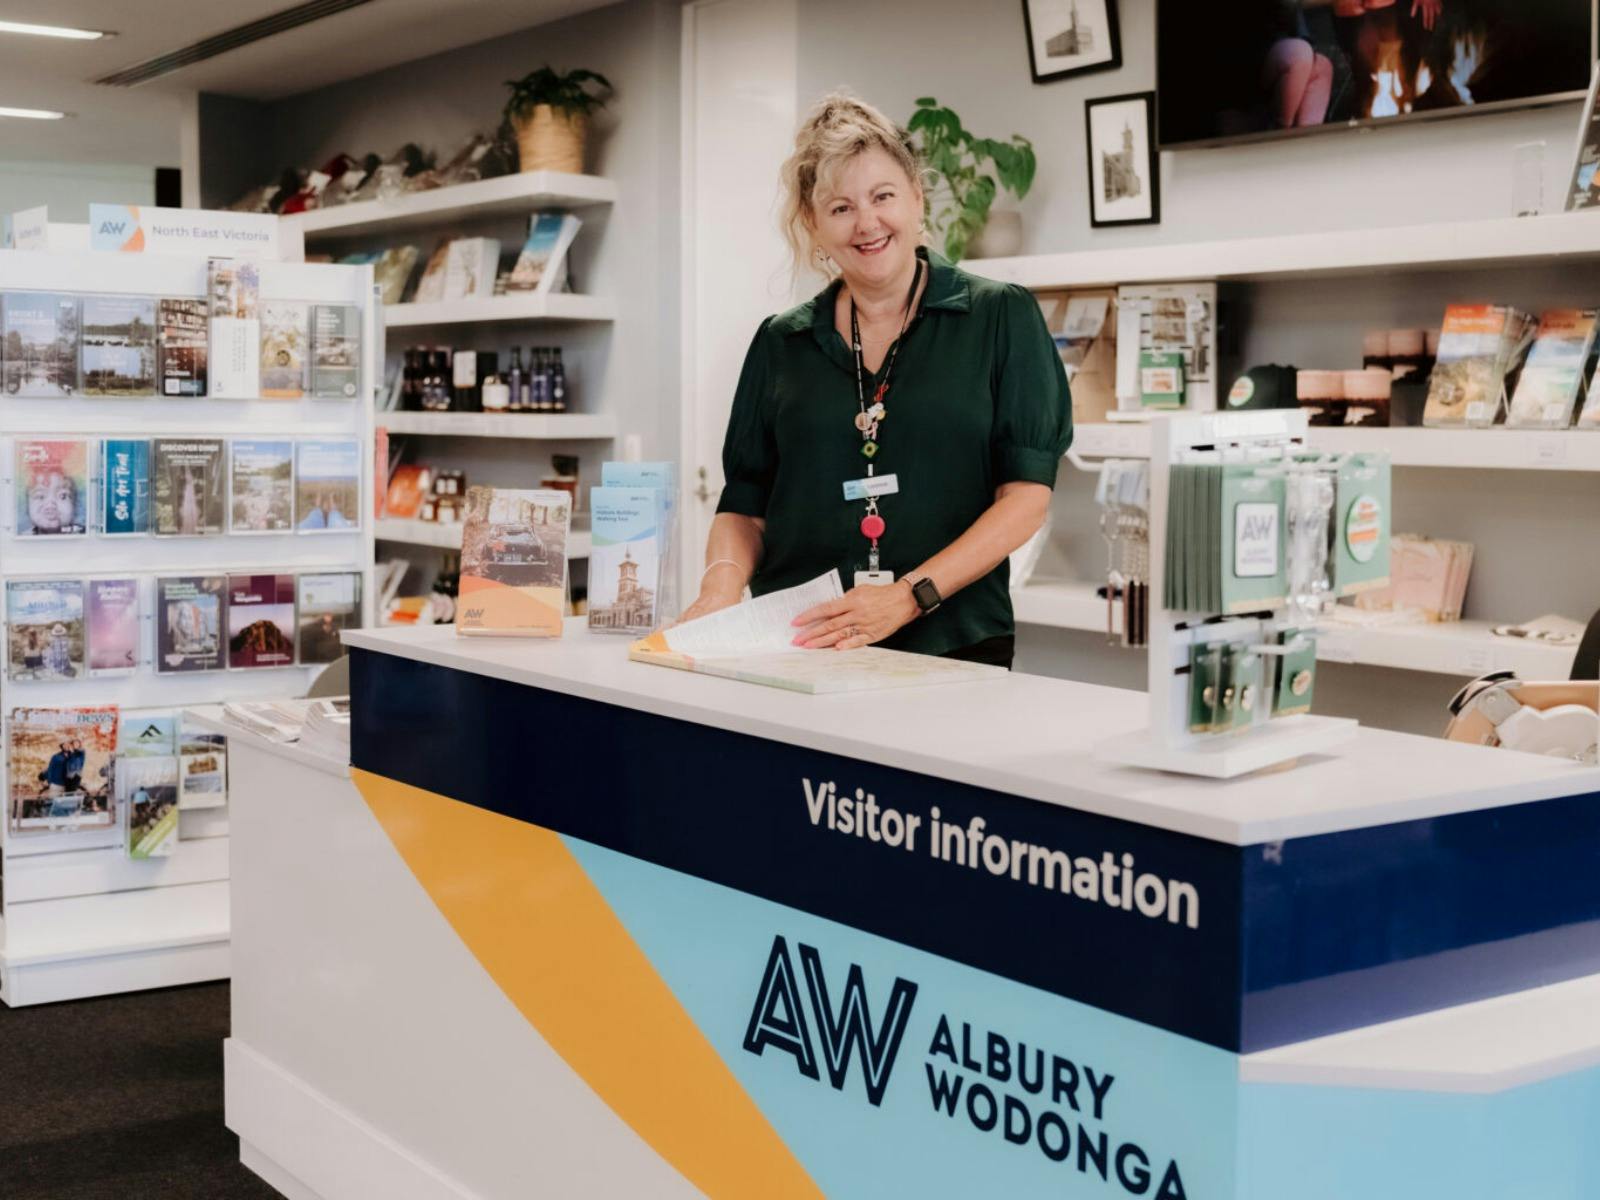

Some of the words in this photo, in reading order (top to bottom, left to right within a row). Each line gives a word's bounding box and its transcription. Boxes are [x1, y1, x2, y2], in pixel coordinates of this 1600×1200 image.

[99, 220, 127, 235] AW
[152, 225, 190, 237] North
[192, 227, 219, 239] East
[222, 229, 270, 242] Victoria
[1241, 515, 1273, 541] AW
[464, 608, 485, 618] AW
[802, 777, 921, 852] Visitor
[931, 806, 1200, 929] information
[742, 934, 919, 1108] AW
[929, 1013, 1116, 1120] ALBURY
[926, 1062, 1187, 1200] WODONGA
